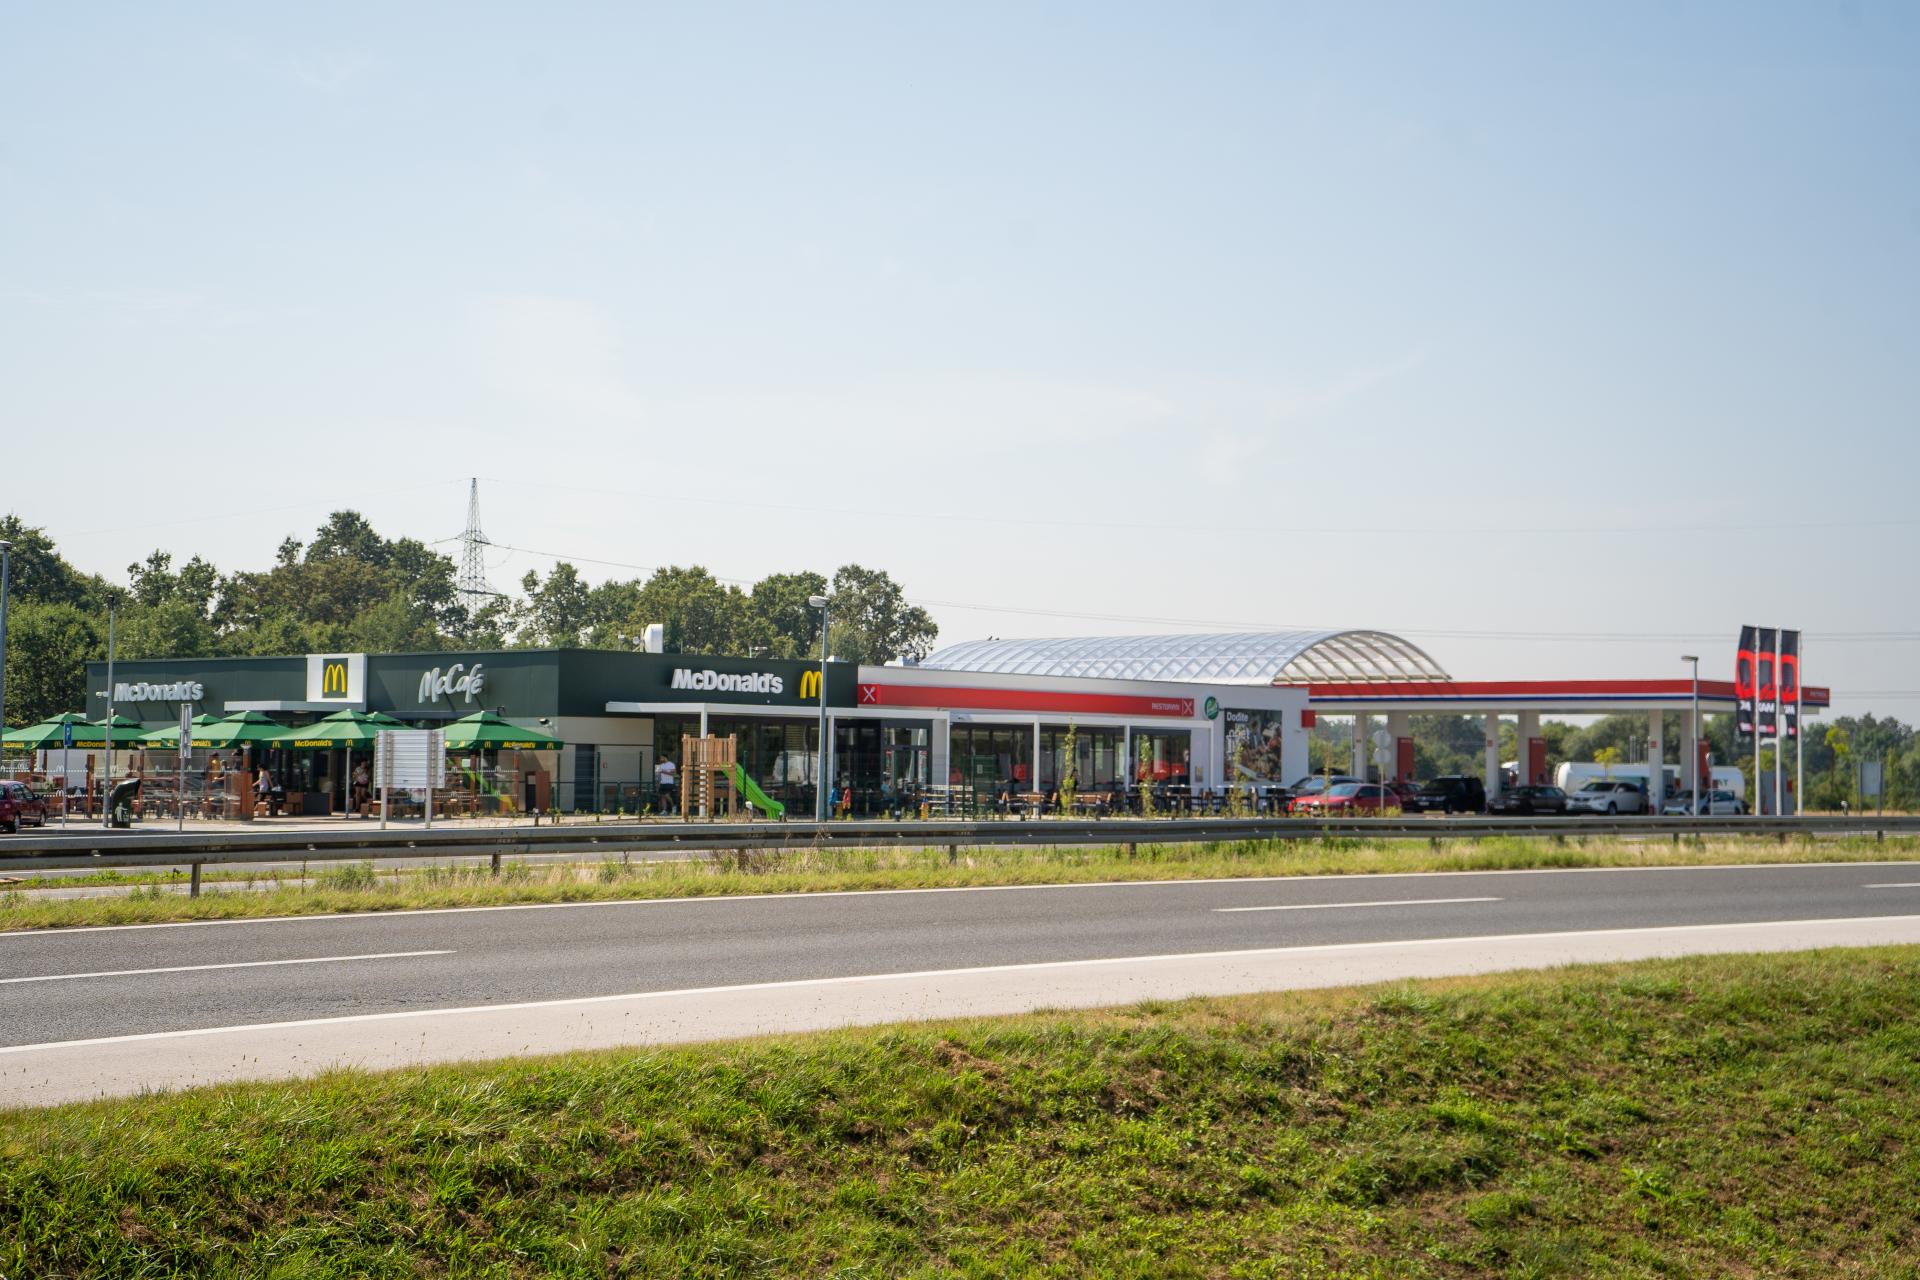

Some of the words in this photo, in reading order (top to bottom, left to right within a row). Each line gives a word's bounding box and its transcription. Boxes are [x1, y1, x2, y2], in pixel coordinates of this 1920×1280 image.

[113, 681, 204, 701] McDonald's
[418, 663, 485, 703] McCafé
[671, 668, 784, 694] McDonald's
[1226, 711, 1249, 722] Dodite
